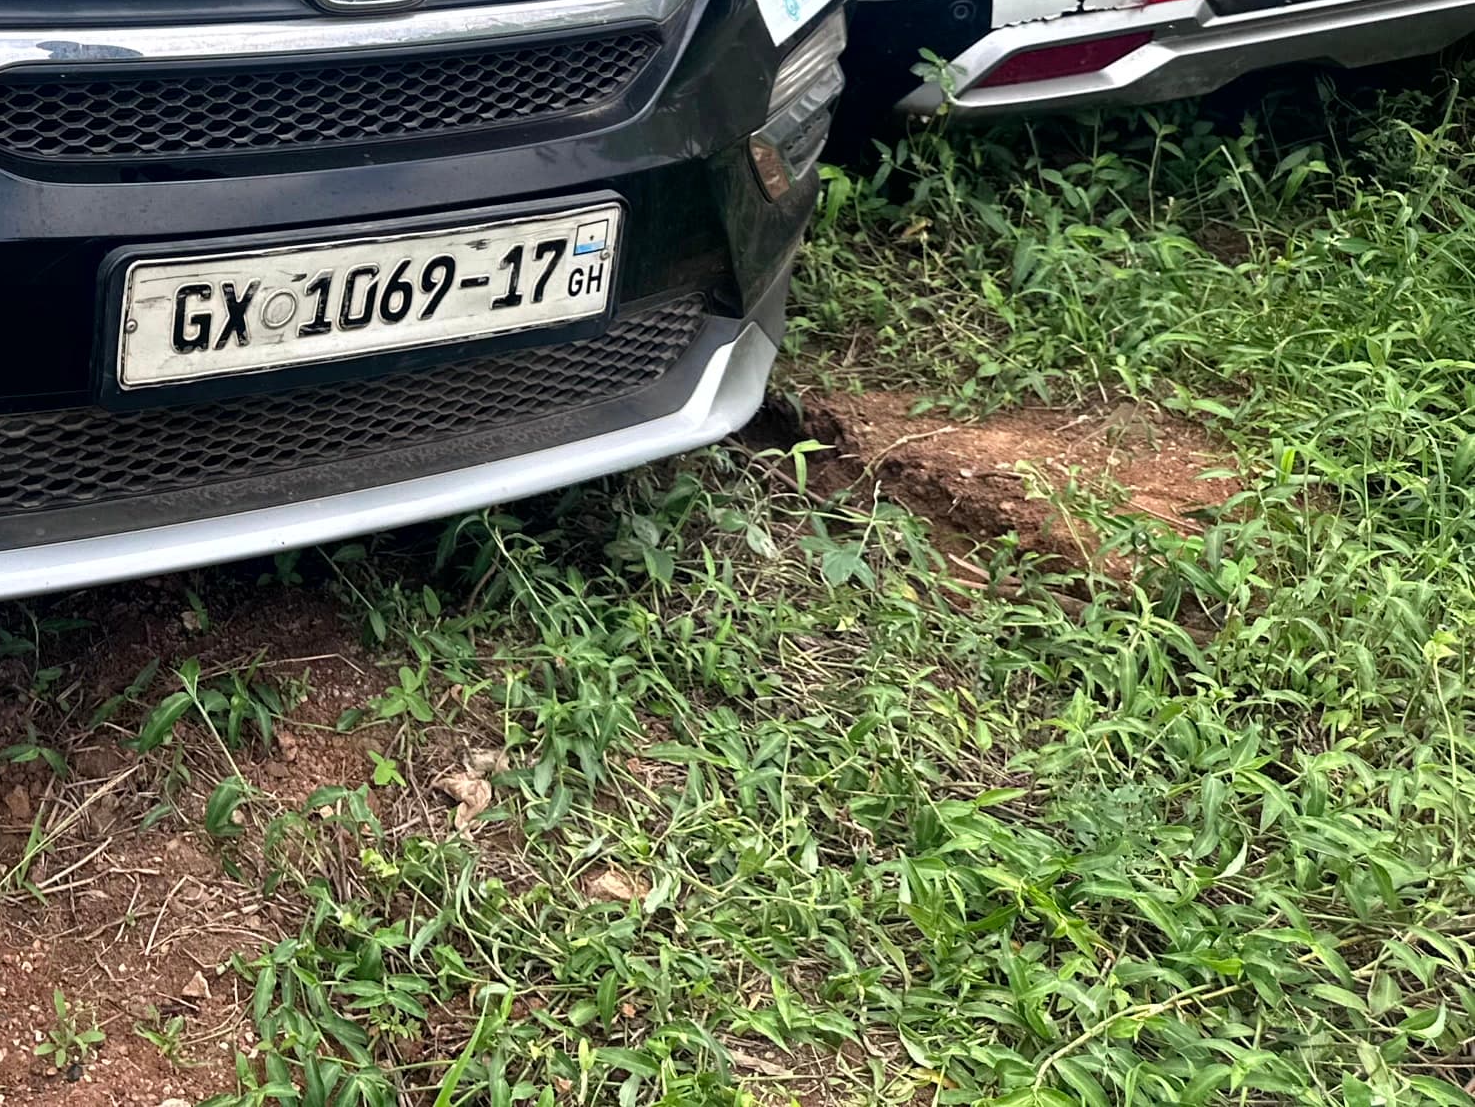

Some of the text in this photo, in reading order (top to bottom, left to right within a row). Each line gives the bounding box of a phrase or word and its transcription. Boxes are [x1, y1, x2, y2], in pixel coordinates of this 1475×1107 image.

[172, 238, 568, 354] GX 1069-17
[567, 262, 602, 297] GH
